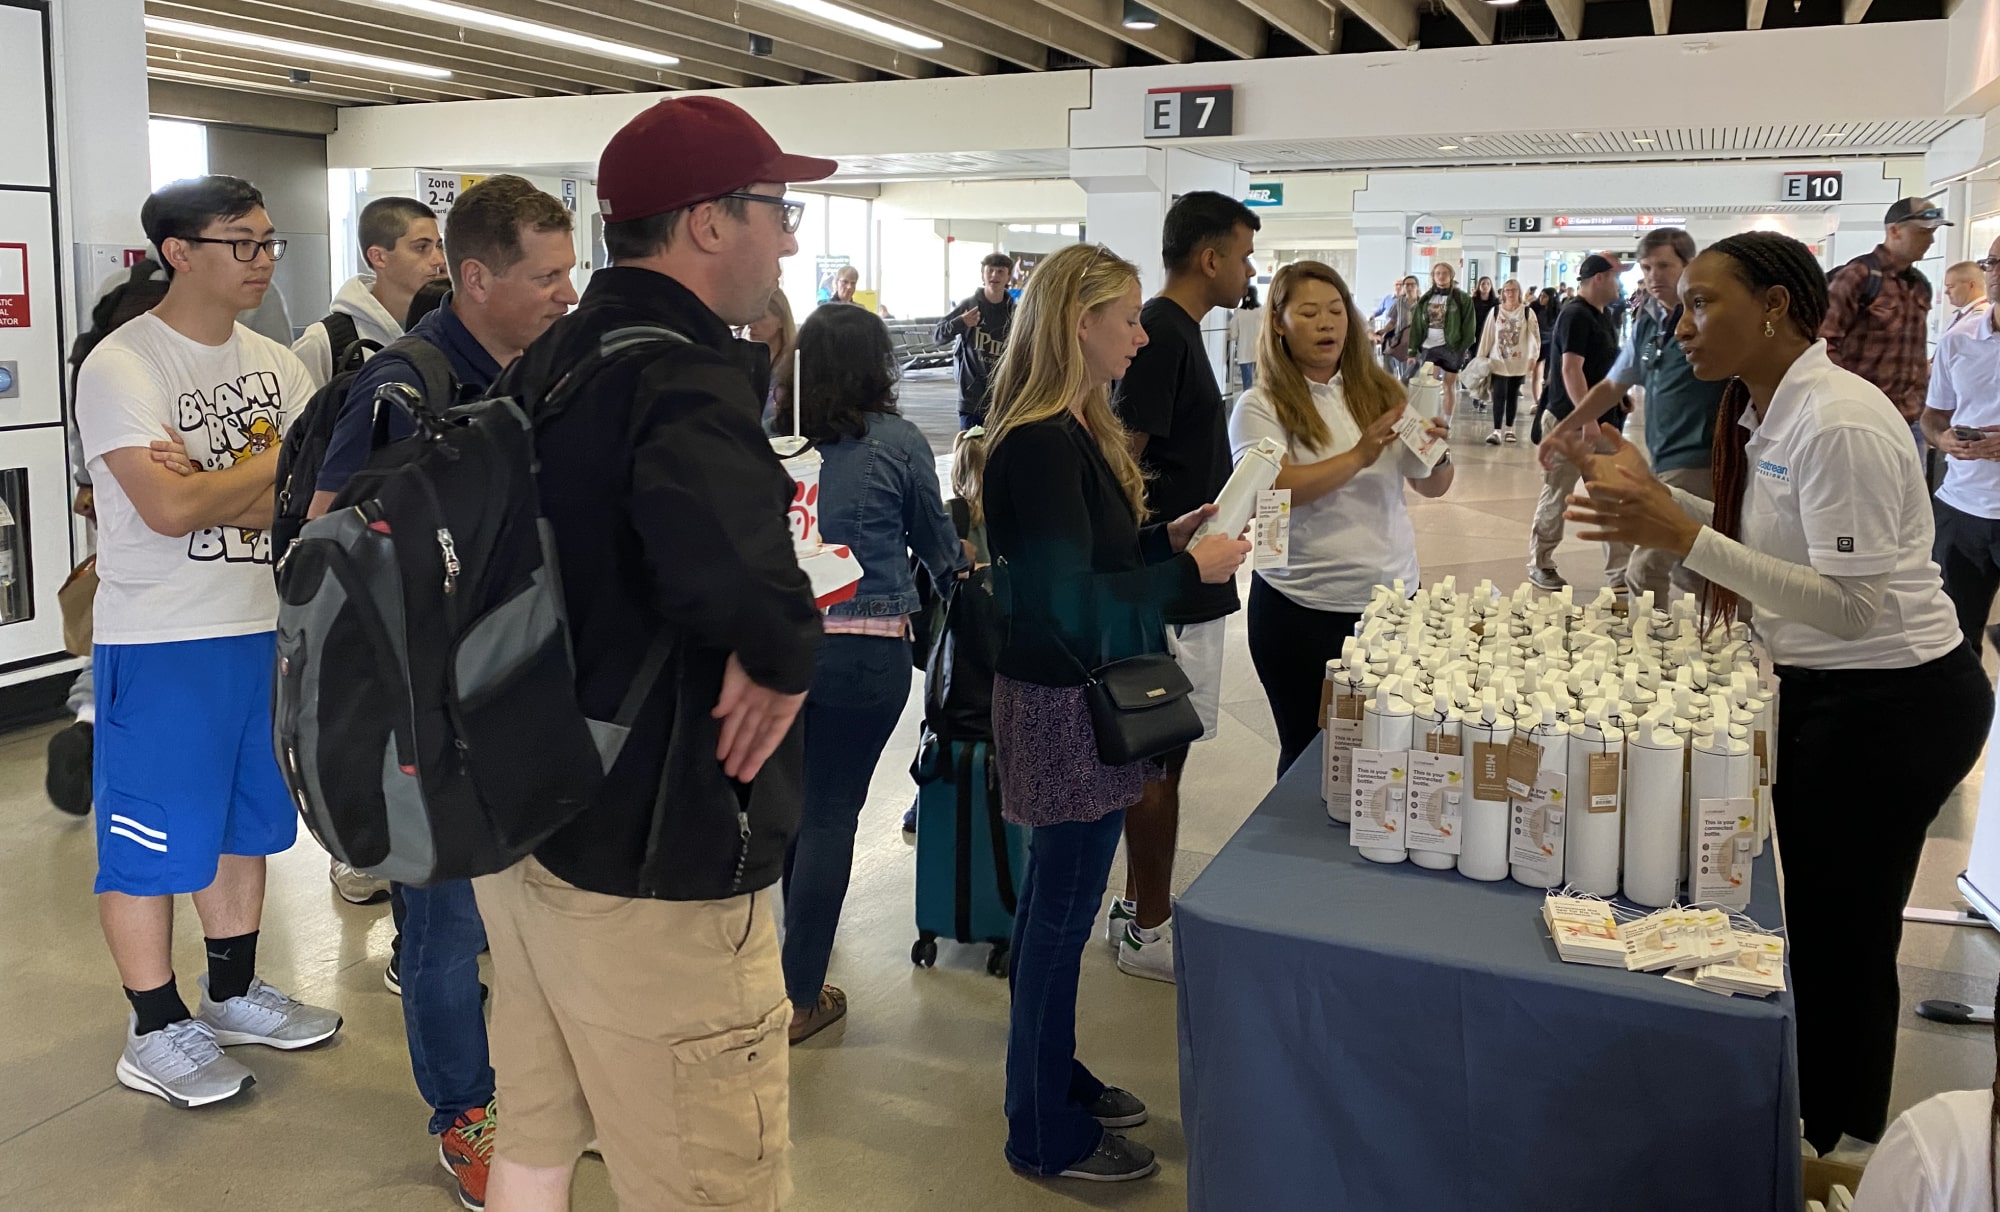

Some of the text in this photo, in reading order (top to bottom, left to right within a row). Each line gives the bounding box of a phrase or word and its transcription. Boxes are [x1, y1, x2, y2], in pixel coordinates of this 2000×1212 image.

[1154, 97, 1216, 130] E 7
[428, 178, 454, 189] Zone
[566, 183, 573, 195] E
[1788, 177, 1839, 197] E 10
[429, 191, 454, 206] 2-4
[566, 198, 573, 209] 7
[1509, 217, 1535, 230] E 9
[0, 298, 13, 306] TIC
[179, 372, 281, 431] BLAM!
[1485, 753, 1496, 780] MiiR
[1413, 775, 1443, 783] connected
